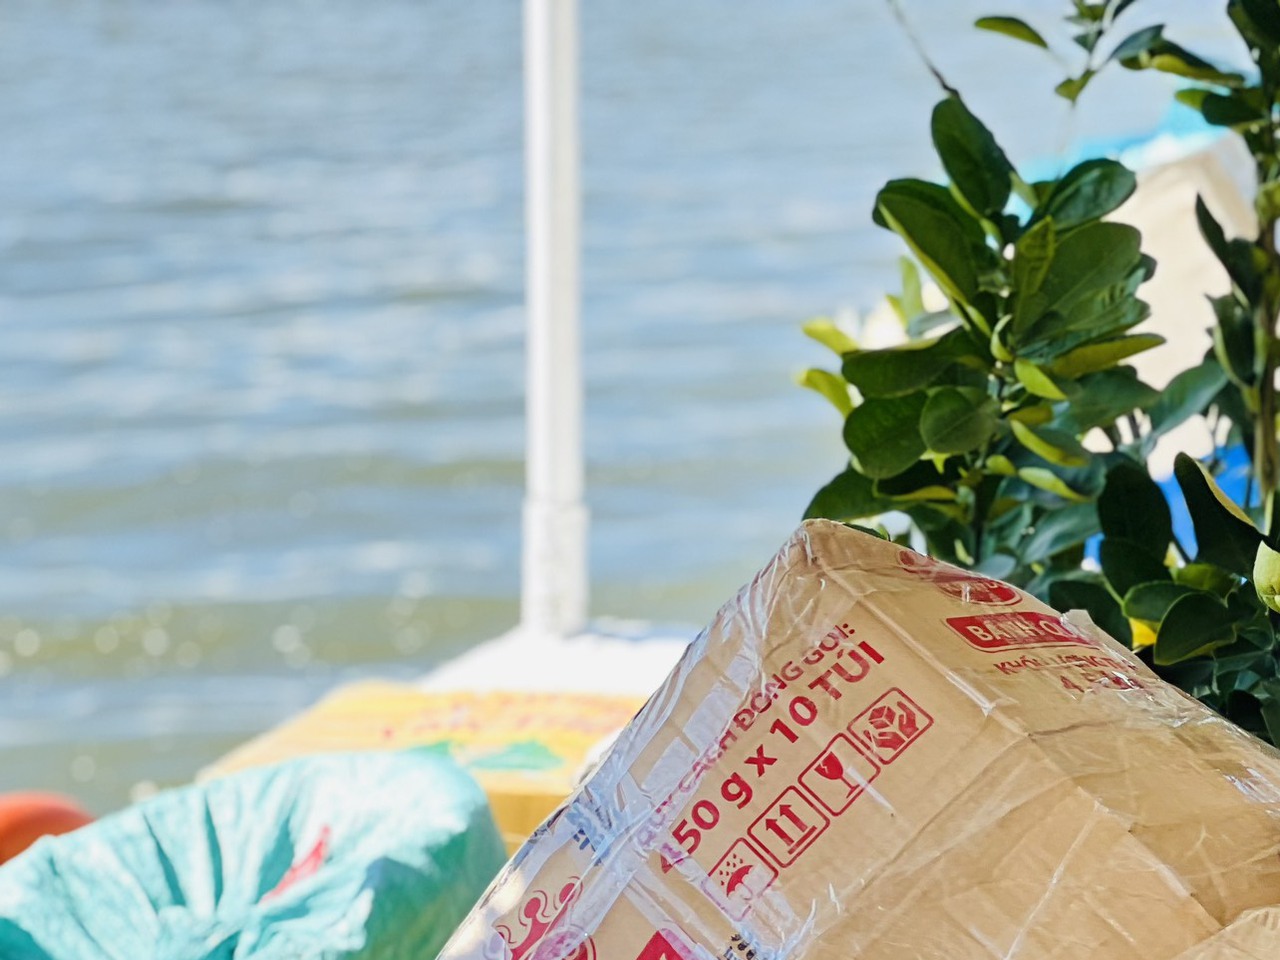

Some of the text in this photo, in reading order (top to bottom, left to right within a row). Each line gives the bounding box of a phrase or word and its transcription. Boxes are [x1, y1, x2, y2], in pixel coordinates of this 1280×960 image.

[720, 772, 753, 809] g
[744, 744, 778, 777] x
[769, 695, 818, 744] 10
[807, 641, 885, 701] TÚI
